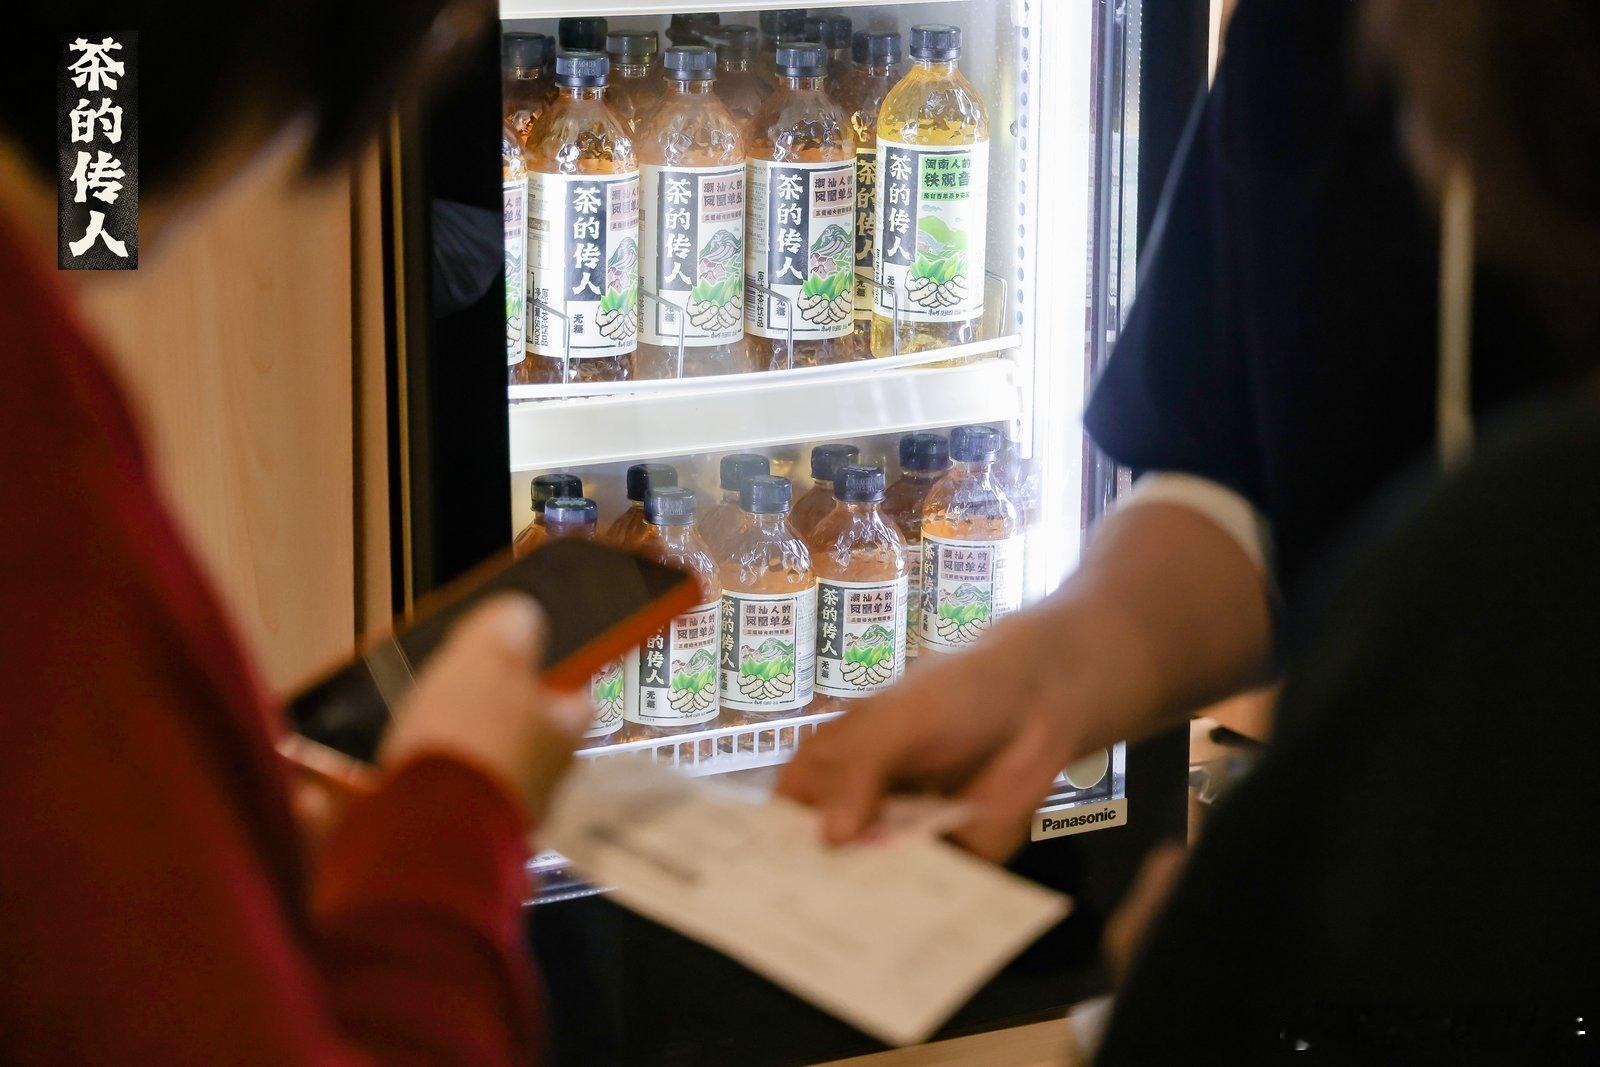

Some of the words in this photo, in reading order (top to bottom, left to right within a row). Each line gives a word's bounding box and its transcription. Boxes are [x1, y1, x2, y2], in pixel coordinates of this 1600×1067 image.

[924, 172, 970, 187] 铁观音
[925, 158, 970, 169] 闽南人的
[664, 179, 692, 286] 茶的传人
[775, 173, 803, 280] 茶的传人
[888, 153, 911, 260] 茶的传人
[572, 186, 601, 295] 茶的传人
[746, 604, 791, 615] 潮汕人的
[821, 587, 838, 656] 茶的传人
[851, 592, 892, 603] 潮汕人的
[646, 629, 664, 685] 的传人
[721, 598, 735, 668] 茶的传人
[1042, 808, 1116, 832] Panasonic
